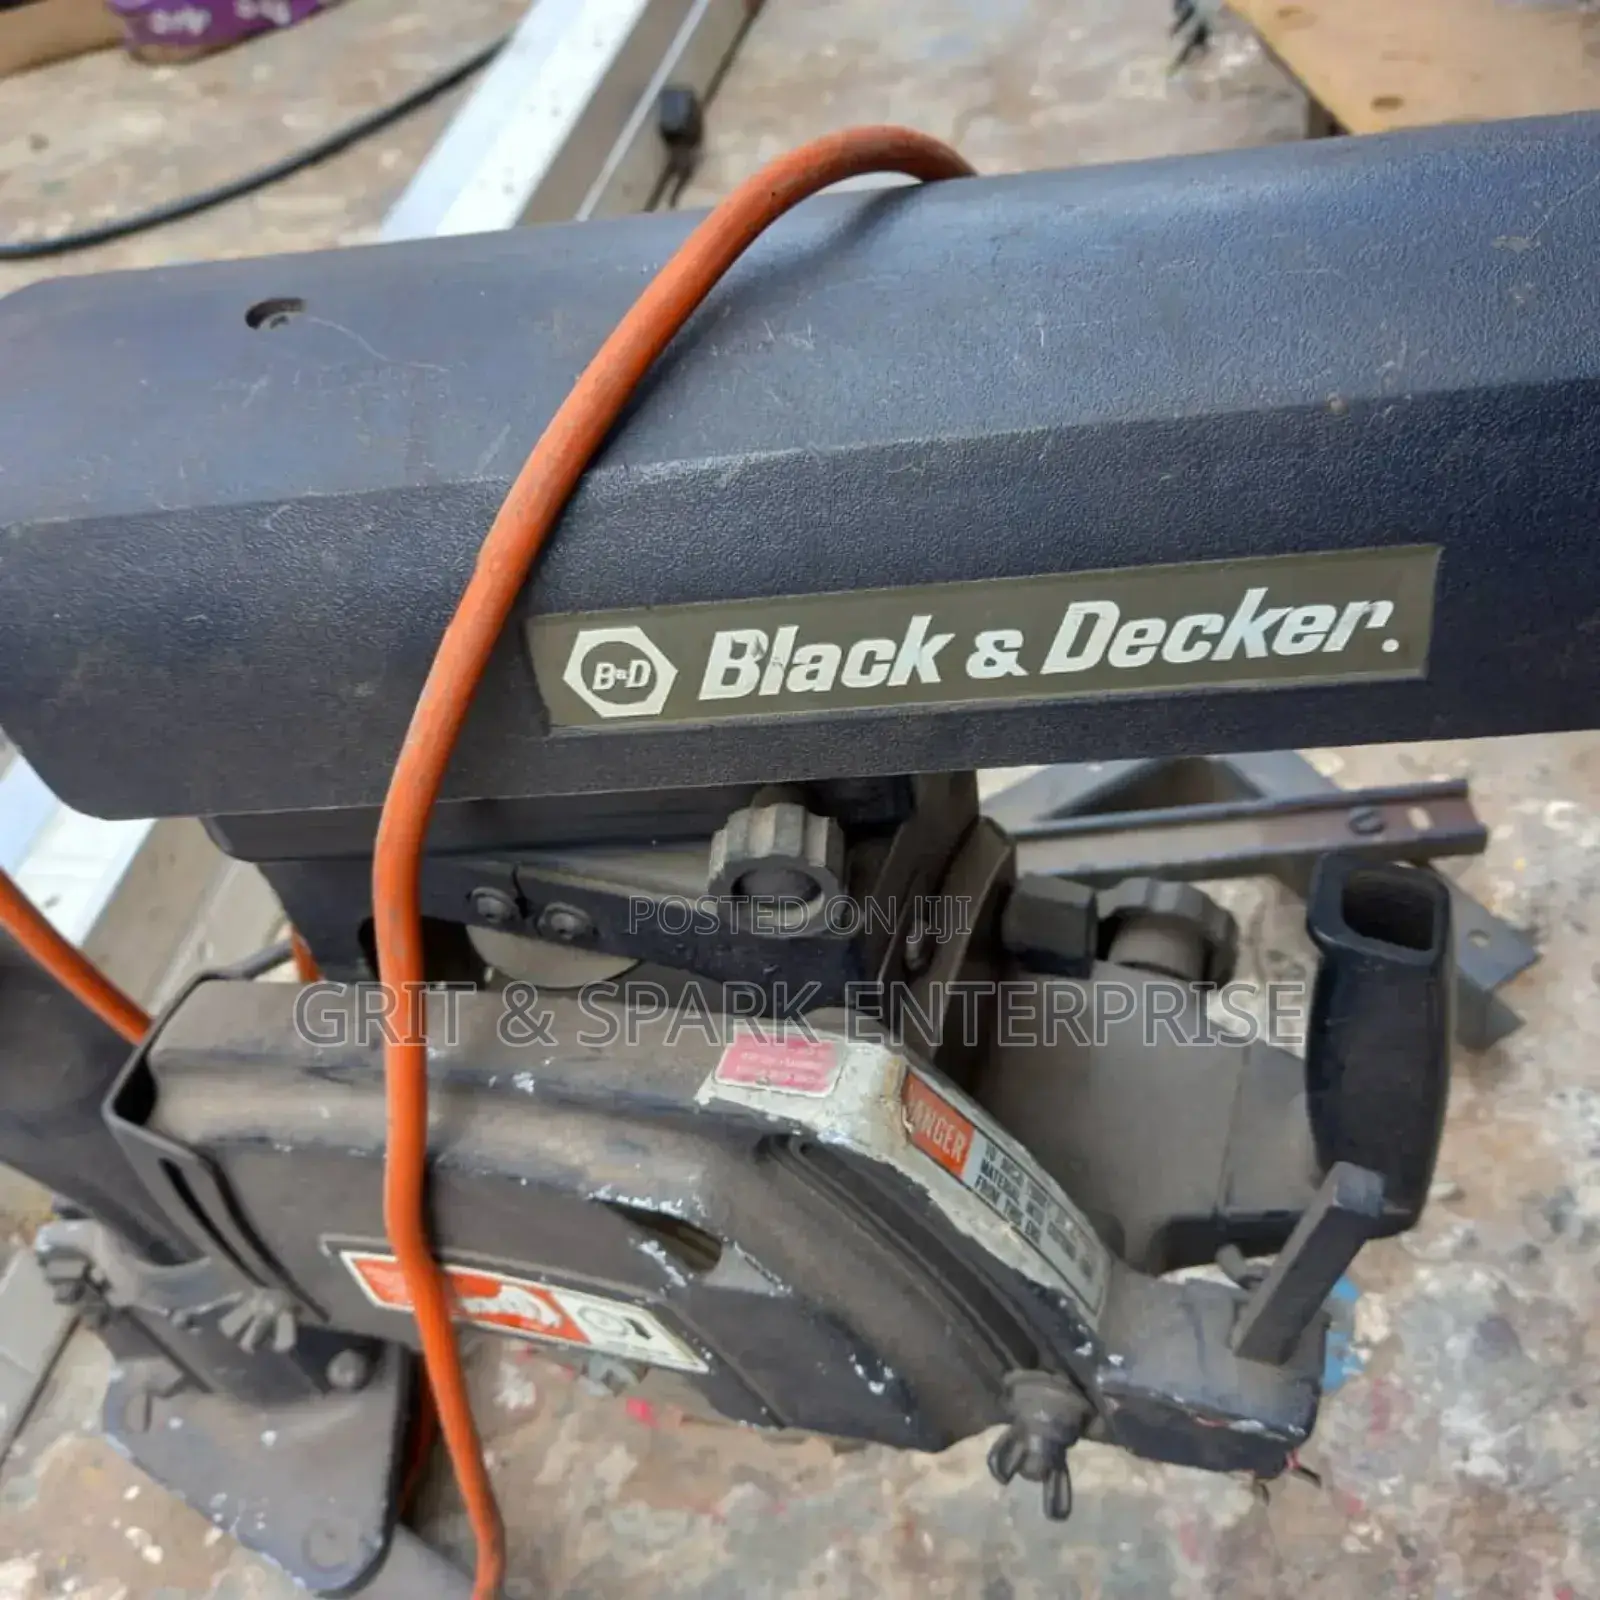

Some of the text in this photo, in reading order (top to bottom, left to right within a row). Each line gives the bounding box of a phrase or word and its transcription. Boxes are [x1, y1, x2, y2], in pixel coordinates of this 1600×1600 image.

[699, 587, 1400, 700] Black & Decker.
